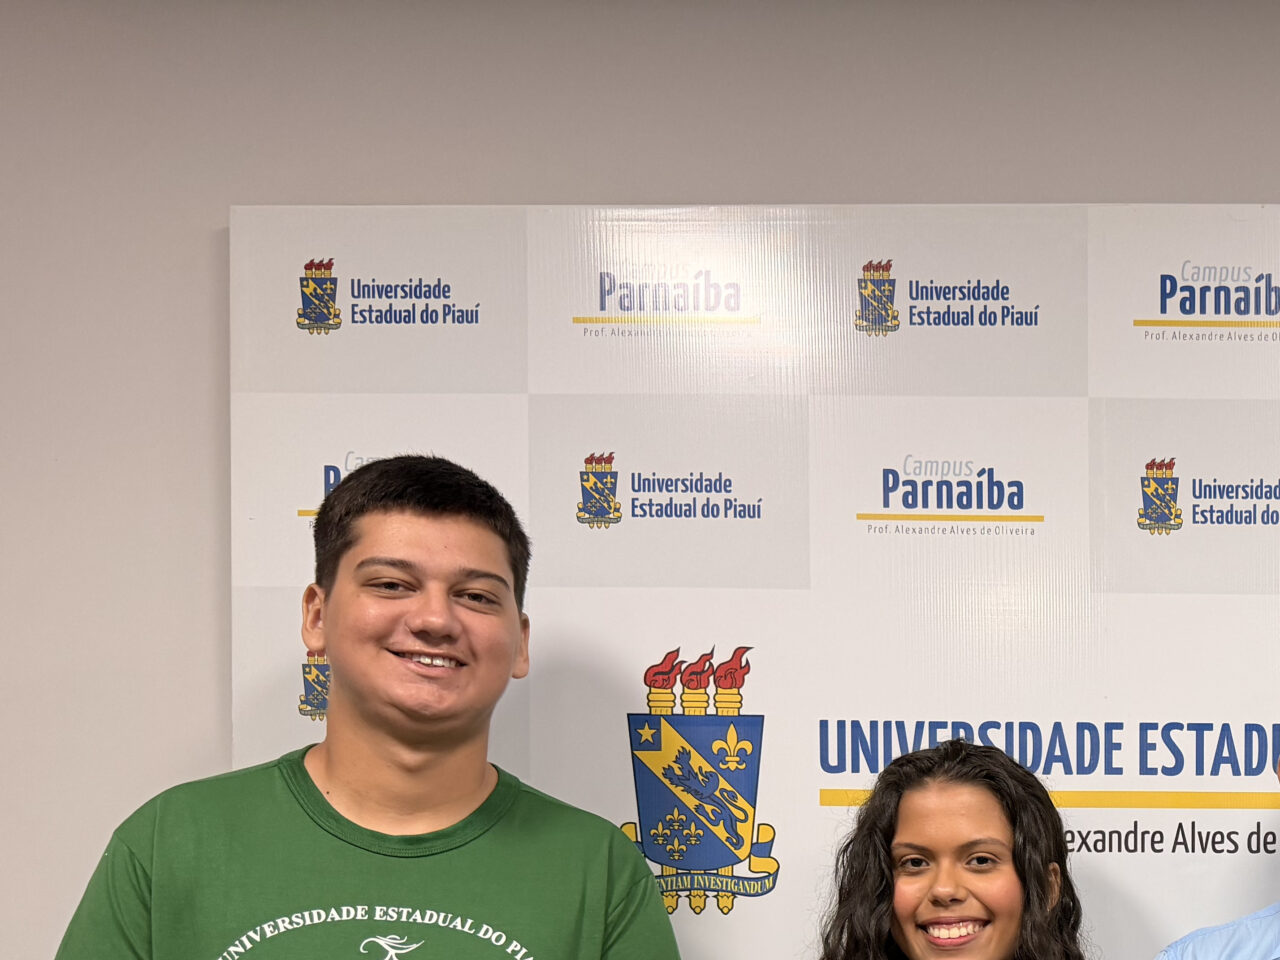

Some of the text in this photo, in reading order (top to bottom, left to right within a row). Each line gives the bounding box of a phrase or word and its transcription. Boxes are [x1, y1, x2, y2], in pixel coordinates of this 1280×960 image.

[1181, 260, 1252, 285] Campus
[350, 277, 451, 300] Universidade
[600, 270, 741, 312] Parnaíba
[908, 279, 1010, 301] Universidade
[351, 302, 480, 325] Estadual do Piauí
[909, 304, 1040, 327] Estadual do Piauí
[1144, 331, 1168, 341] Prof.
[1172, 331, 1224, 341] Alexandre
[1227, 331, 1255, 342] Alves
[1258, 332, 1269, 342] de
[903, 454, 974, 480] Campus
[631, 471, 733, 494] Universidade
[882, 467, 1024, 510] Parnaíba
[631, 496, 763, 519] Estadual do Piauí
[1192, 503, 1257, 526] Estadual
[1260, 503, 1280, 526] do
[867, 524, 1035, 536] Prof. Alexandre Alves de Oliveira
[1138, 722, 1279, 777] ESTAD
[1064, 820, 1165, 854] exandre
[1171, 820, 1240, 854] Alves
[1247, 821, 1277, 855] de
[660, 876, 774, 894] NTIAM INVESTIGANDUM
[374, 906, 476, 935] ESTADUAL
[477, 924, 507, 946] DO
